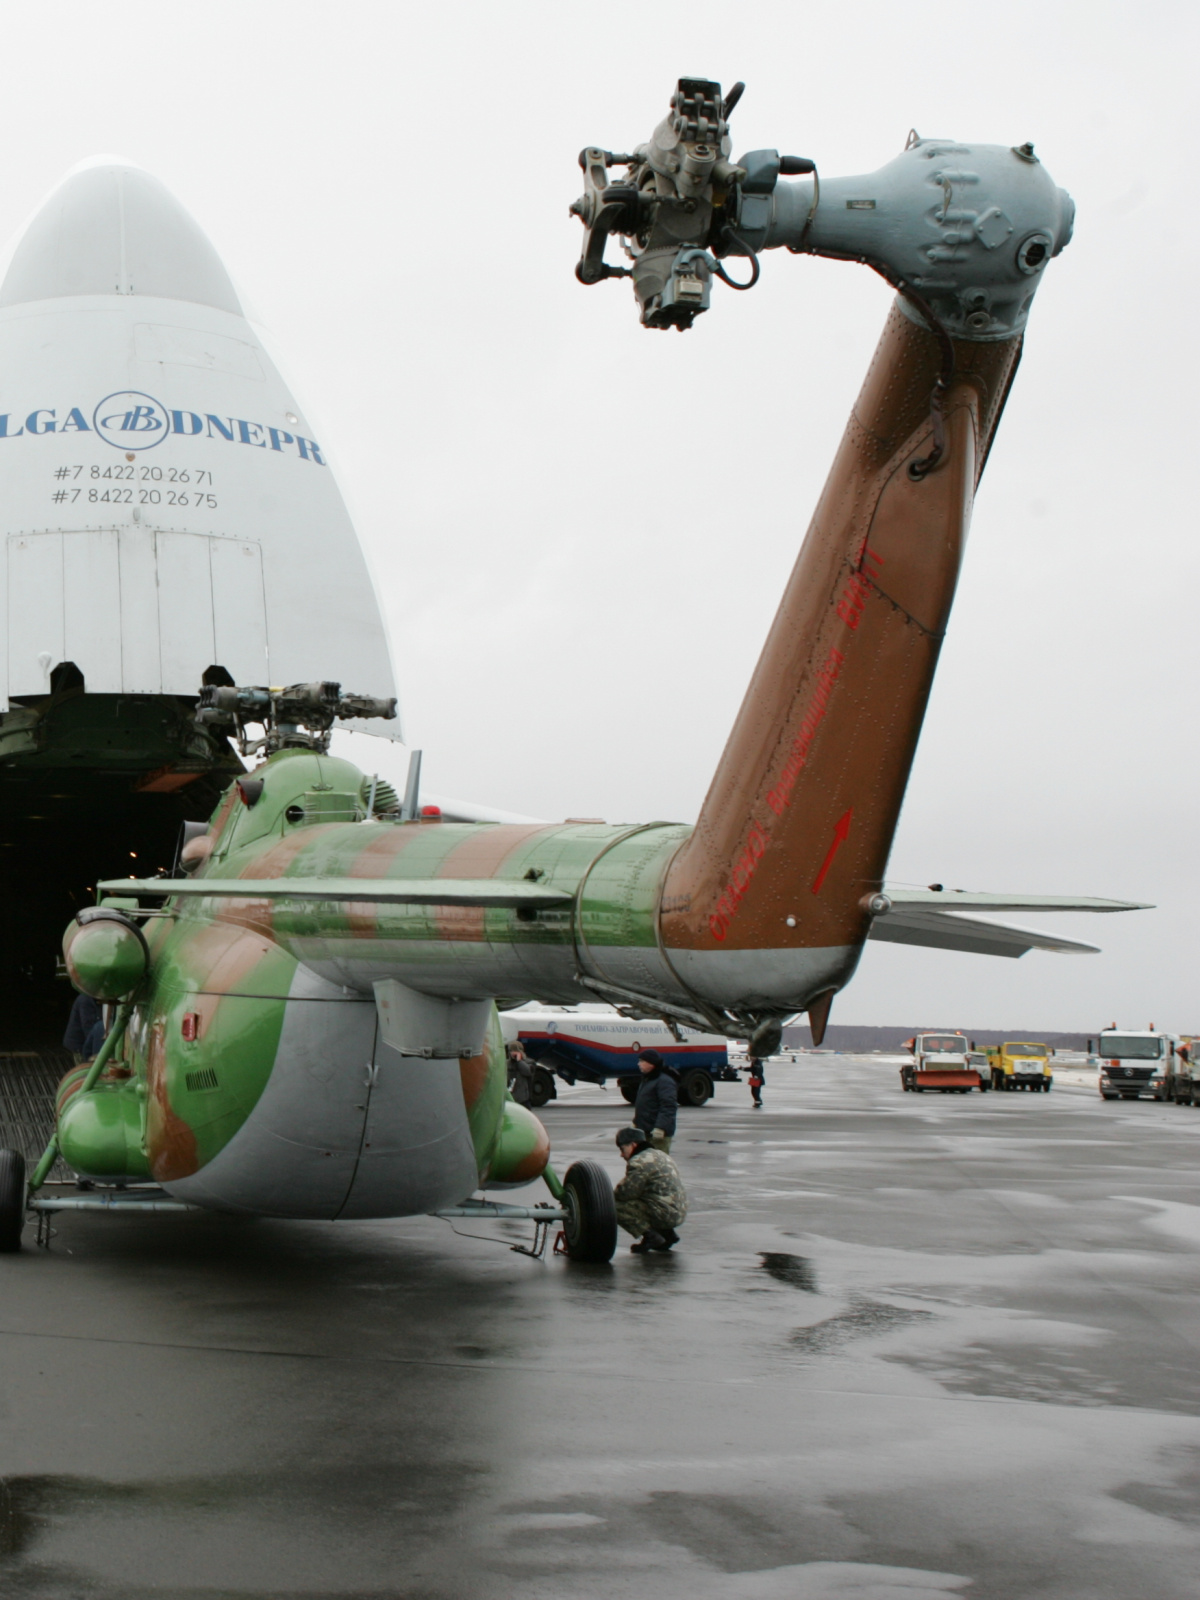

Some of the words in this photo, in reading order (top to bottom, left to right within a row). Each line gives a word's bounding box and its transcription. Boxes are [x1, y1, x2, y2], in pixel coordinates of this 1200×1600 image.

[168, 409, 326, 466] DNEPR
[53, 465, 83, 481] #7
[90, 465, 135, 480] 8422
[140, 466, 163, 481] 20
[168, 467, 190, 483] 26
[195, 470, 213, 486] 71
[51, 488, 82, 504] #7
[87, 488, 133, 504] 8422
[138, 489, 161, 505] 20
[166, 491, 189, 506] 26
[194, 492, 218, 509] 75
